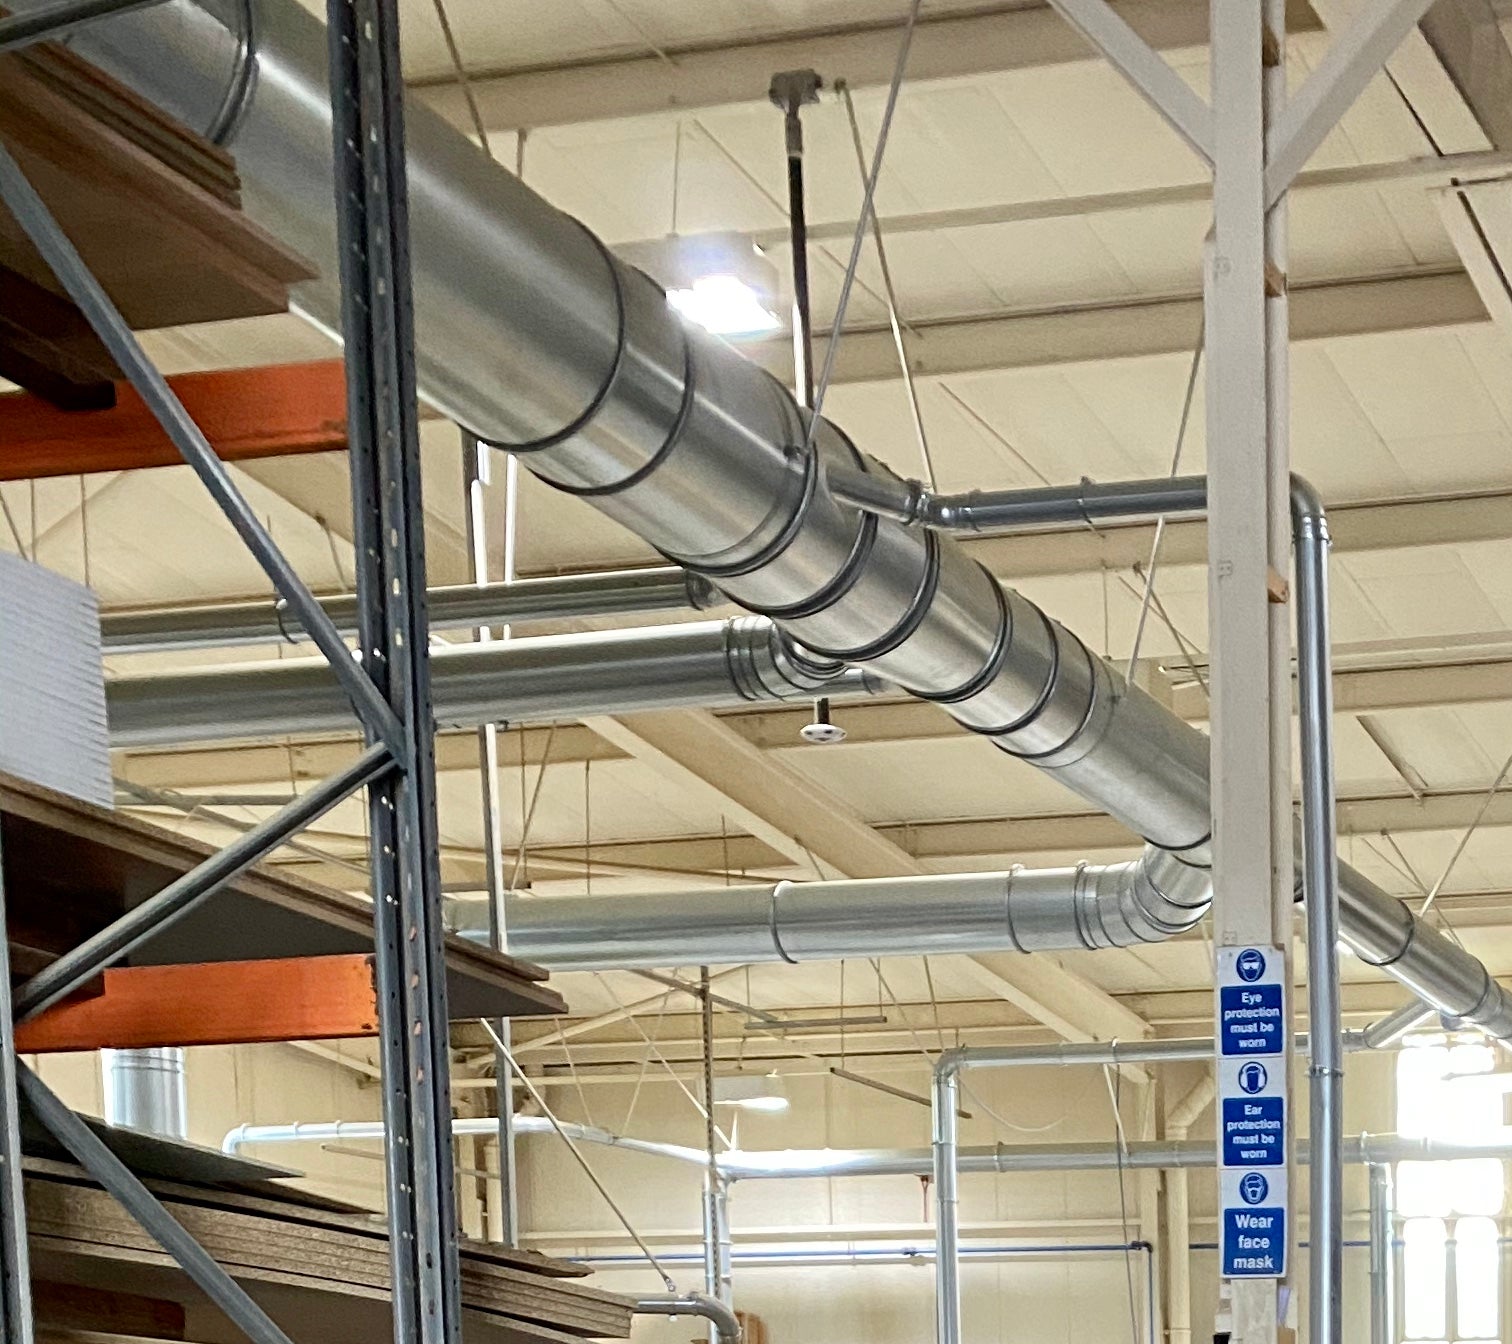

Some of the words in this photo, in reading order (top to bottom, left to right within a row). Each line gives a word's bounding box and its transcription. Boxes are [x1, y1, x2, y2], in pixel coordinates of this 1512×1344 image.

[1241, 991, 1263, 1005] Eye
[1224, 1006, 1280, 1021] protection
[1230, 1022, 1258, 1033] must
[1260, 1021, 1275, 1032] be
[1238, 1038, 1267, 1048] worn
[1244, 1104, 1263, 1115] Ear
[1226, 1118, 1281, 1132] protection
[1232, 1134, 1259, 1144] must
[1260, 1133, 1275, 1144] be
[1240, 1149, 1267, 1159] worn
[1234, 1214, 1274, 1229] Wear
[1237, 1234, 1271, 1249] face
[1233, 1254, 1274, 1269] mask
